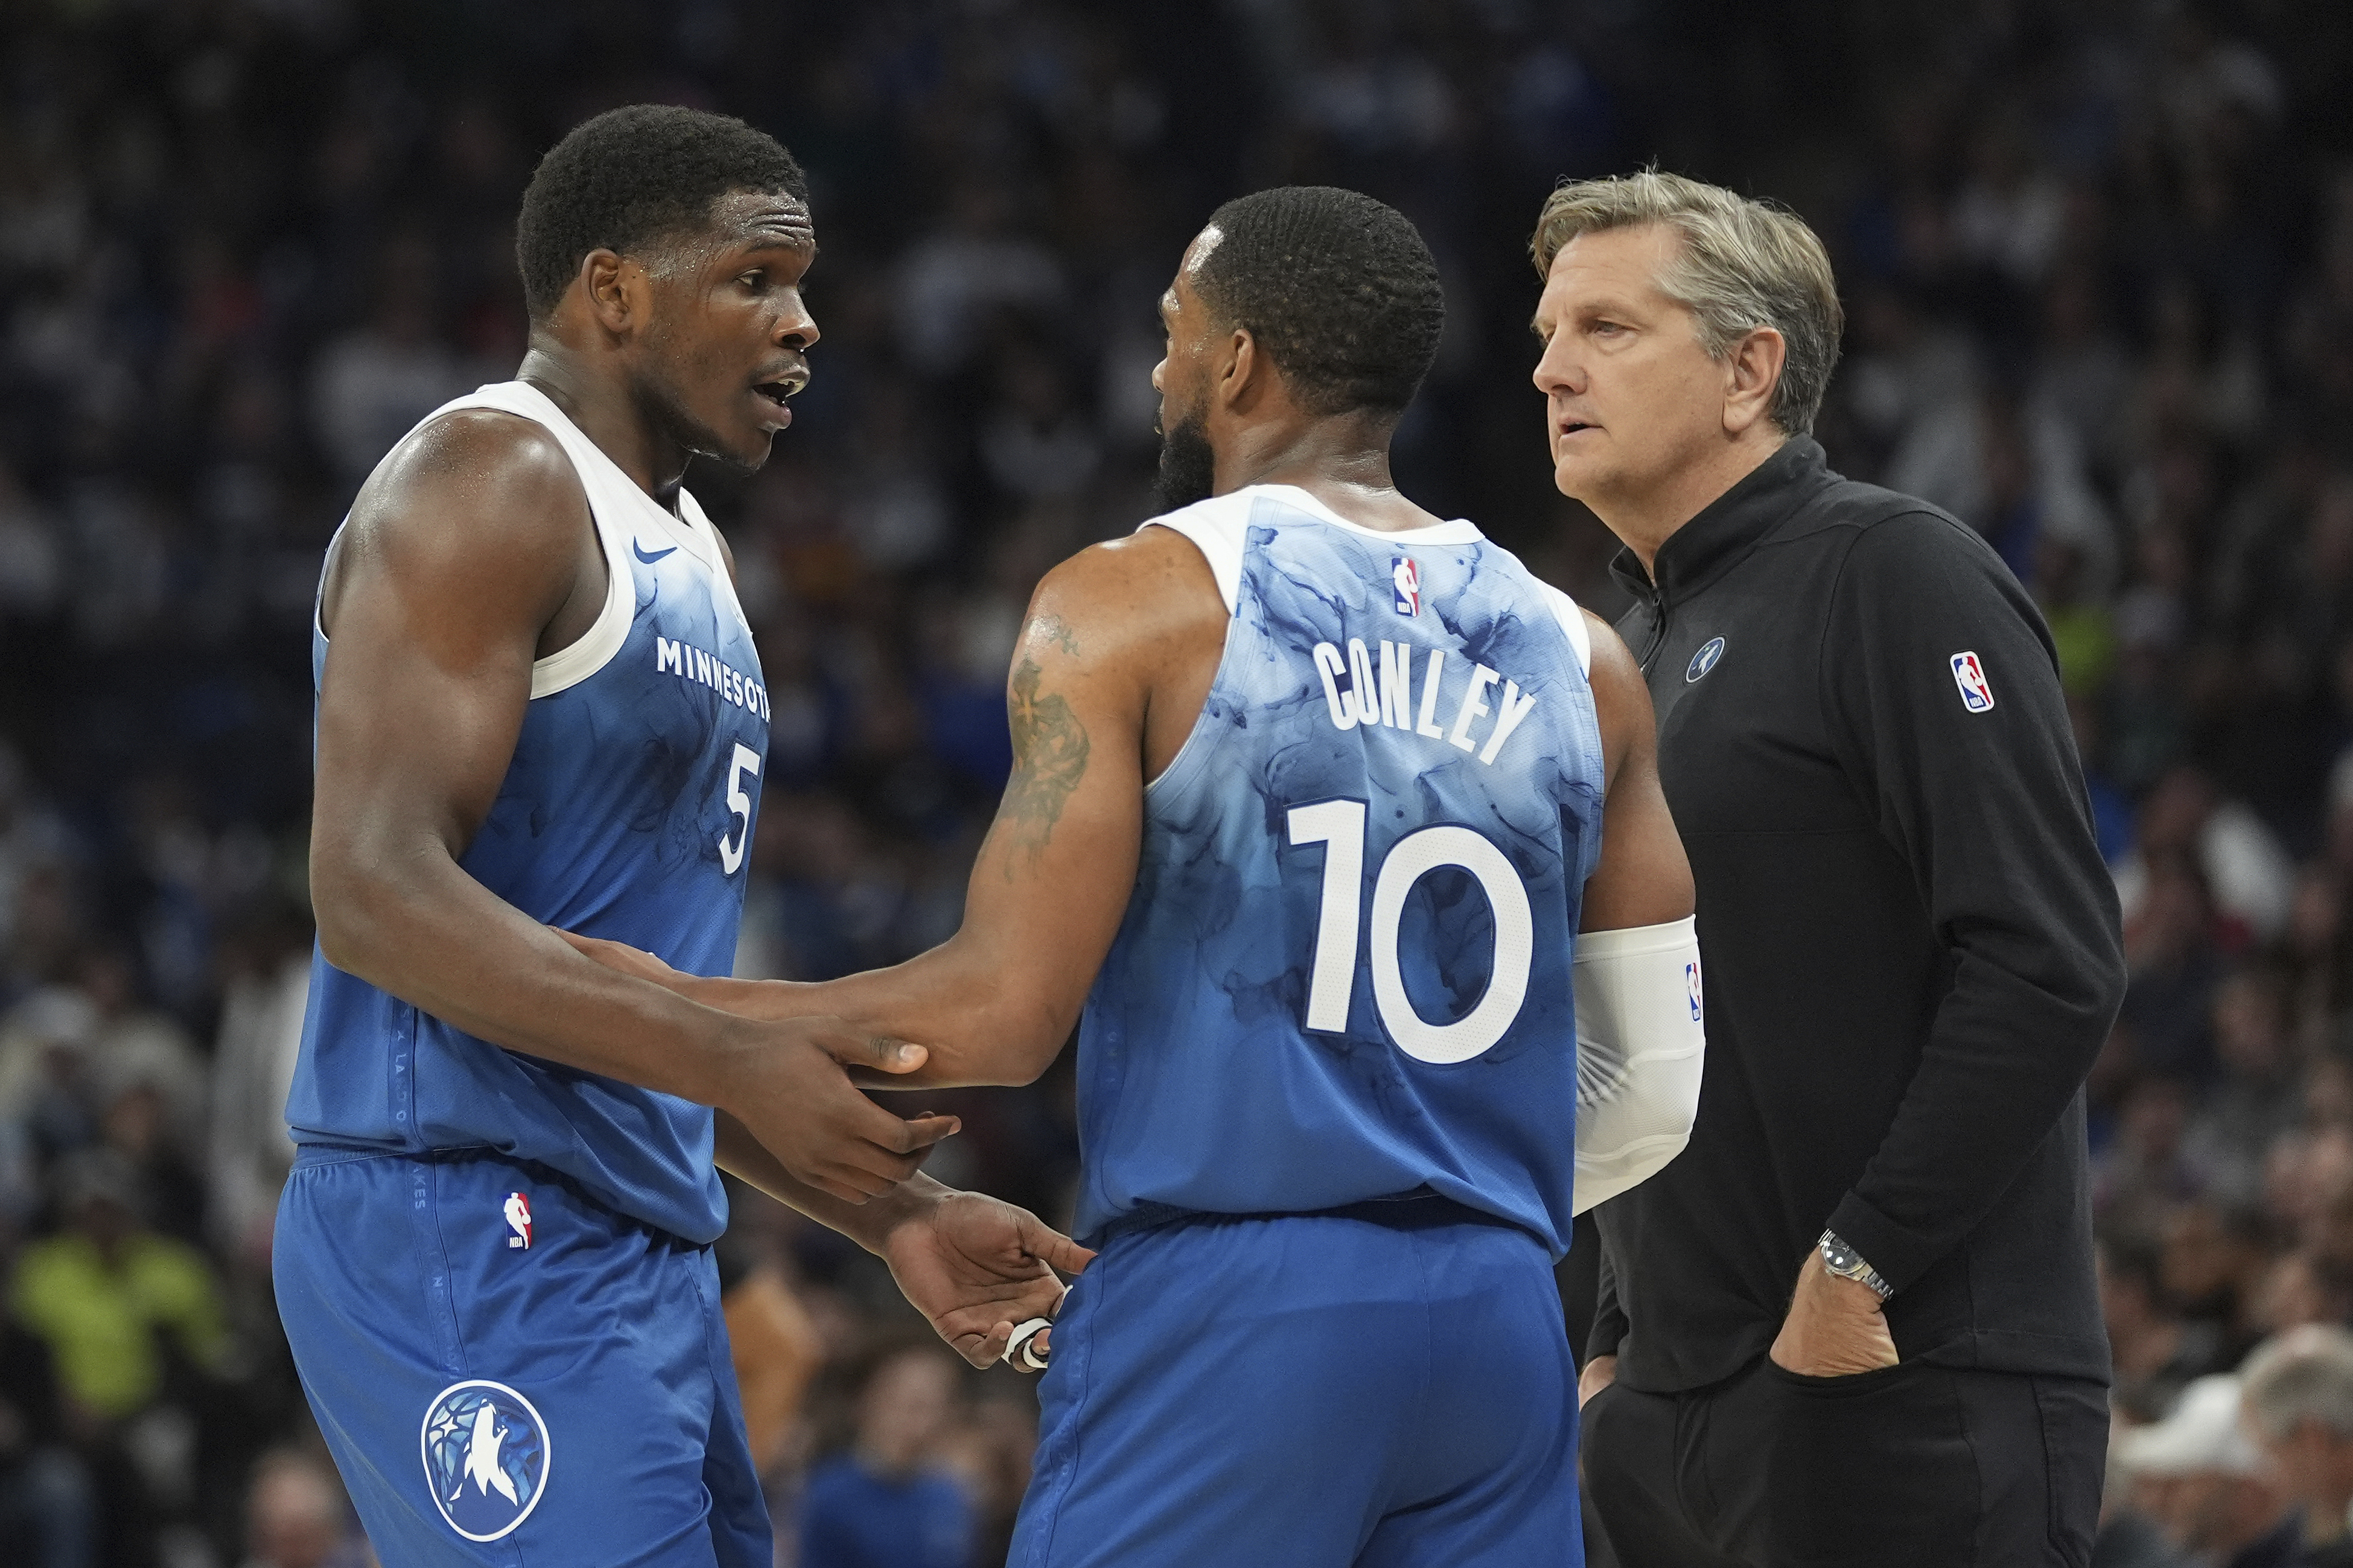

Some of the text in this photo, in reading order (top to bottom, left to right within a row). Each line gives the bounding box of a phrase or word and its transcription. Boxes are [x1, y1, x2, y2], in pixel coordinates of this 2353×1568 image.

[1398, 602, 1410, 612] NBA
[1313, 638, 1536, 766] CONLEY
[1969, 696, 1984, 708] NBA
[719, 743, 760, 874] 5
[1287, 799, 1533, 1065] 10
[510, 1237, 523, 1248] NBA
